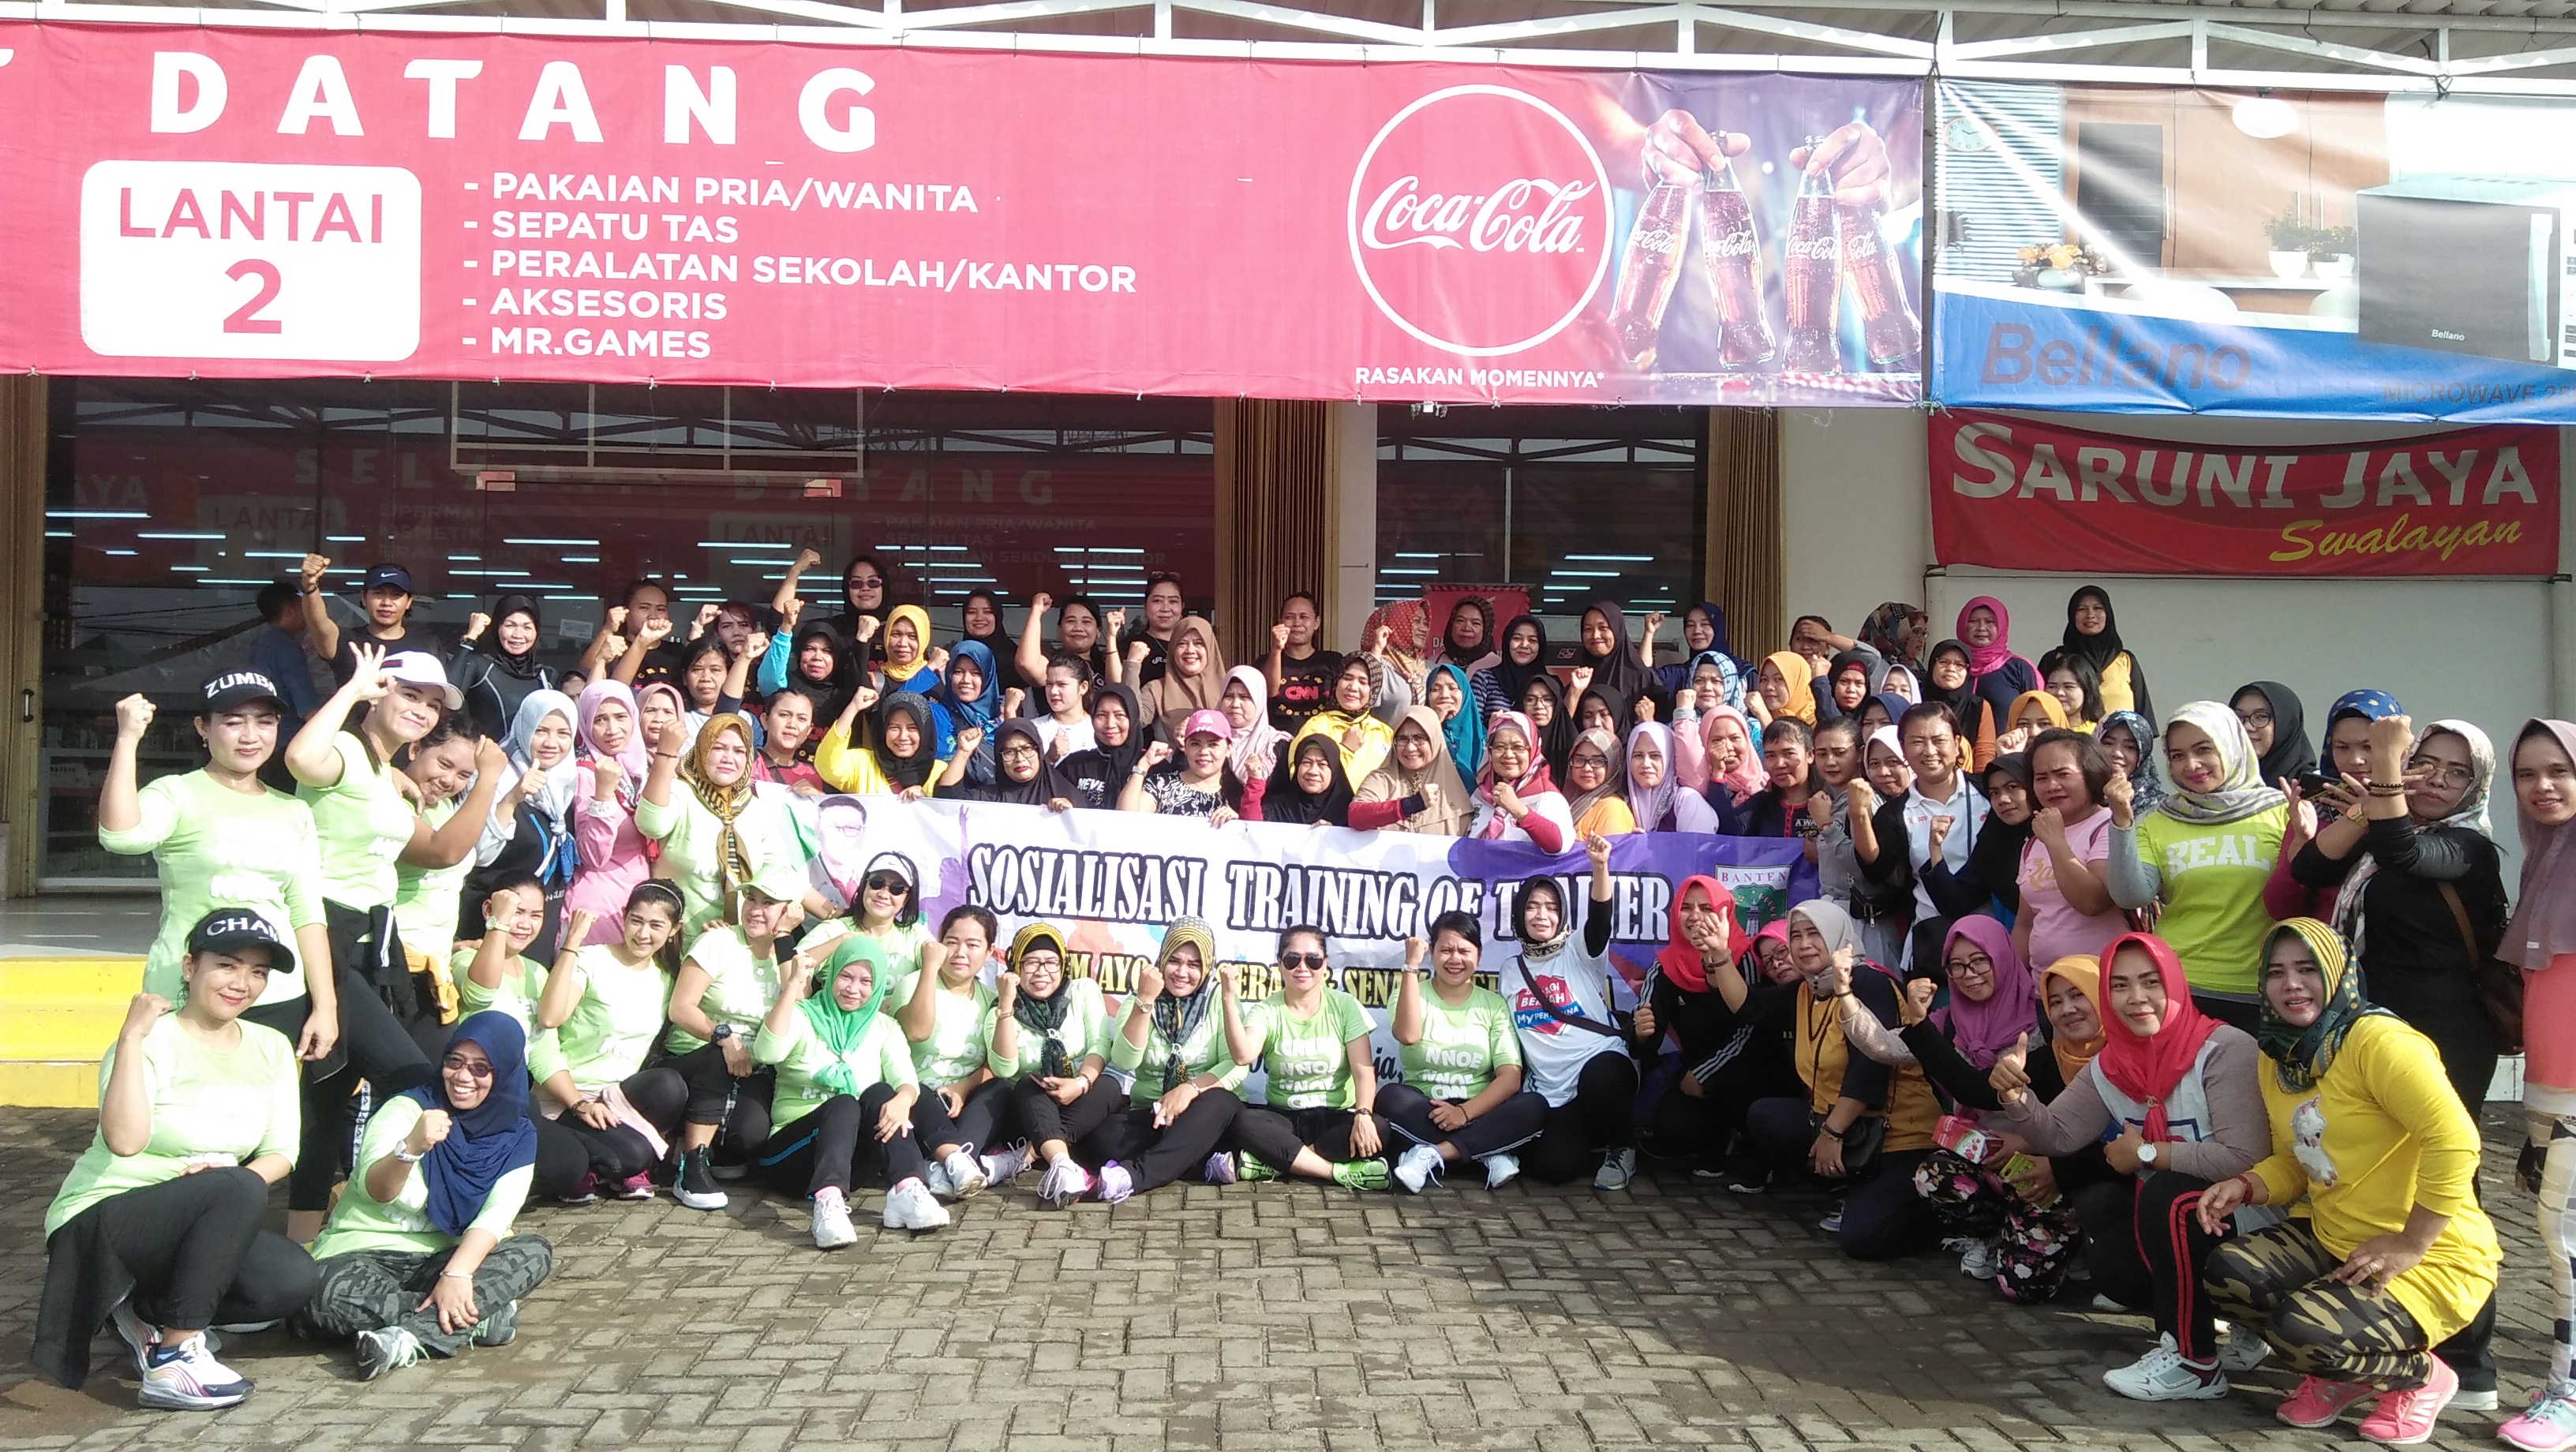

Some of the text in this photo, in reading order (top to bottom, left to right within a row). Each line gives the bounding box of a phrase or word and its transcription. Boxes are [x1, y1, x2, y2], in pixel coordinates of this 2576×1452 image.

[150, 51, 876, 153] DATANG
[492, 171, 979, 213] PAKAIAN PRIA/WANITA
[119, 187, 384, 244] LANTAI
[491, 210, 739, 244] SEPATU TAS
[1362, 175, 1597, 255] Coca-Cola
[492, 249, 1136, 294] PERALATAN SEKOLAH/KANTOR
[223, 258, 283, 335] 2
[490, 288, 728, 320] AKSESORIS
[492, 327, 711, 358] MR.GAMES
[1980, 323, 2252, 392] Bellano
[2431, 328, 2466, 342] Bellano
[1355, 367, 1464, 385] RASAKAN
[2383, 380, 2536, 405] MICROWAVE
[1952, 421, 2538, 510] SARUNI JAYA
[2269, 514, 2524, 562] Swalayan
[1285, 686, 1319, 702] CNN
[1721, 871, 1787, 883] BANTEN
[2166, 835, 2271, 881] REAL
[969, 844, 1208, 923] SOSIALISASI
[1227, 860, 1418, 939] TRAINING
